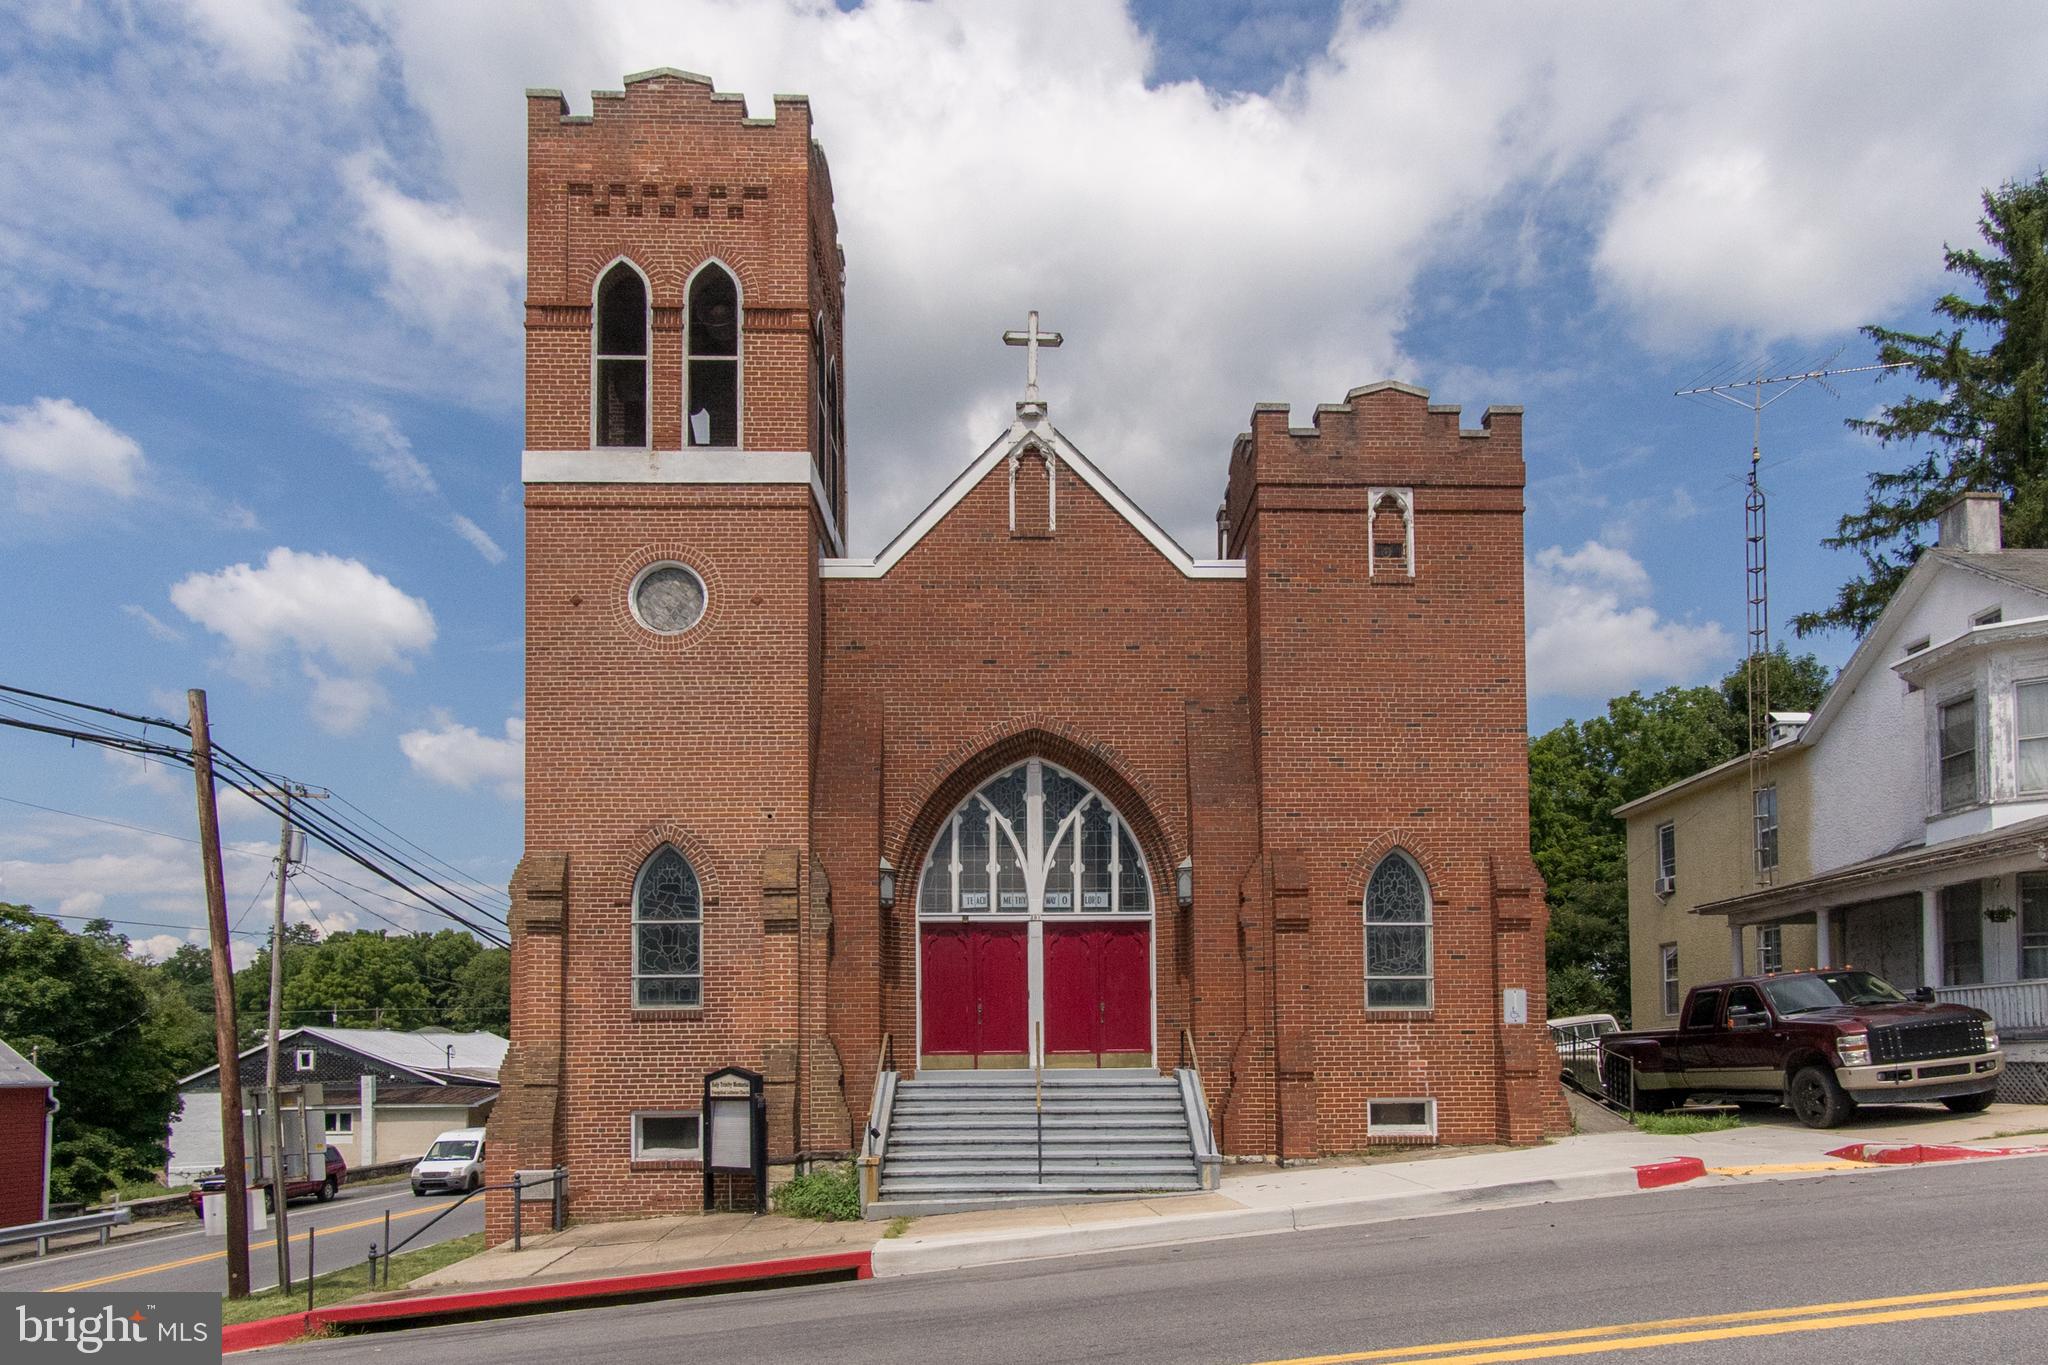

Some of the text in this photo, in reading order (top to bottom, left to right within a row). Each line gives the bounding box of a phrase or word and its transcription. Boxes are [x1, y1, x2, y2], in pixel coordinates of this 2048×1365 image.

[1003, 896, 1012, 905] ME
[1015, 896, 1026, 905] THY
[1046, 896, 1057, 905] WAY
[1062, 896, 1068, 905] O
[1084, 896, 1102, 905] LORD
